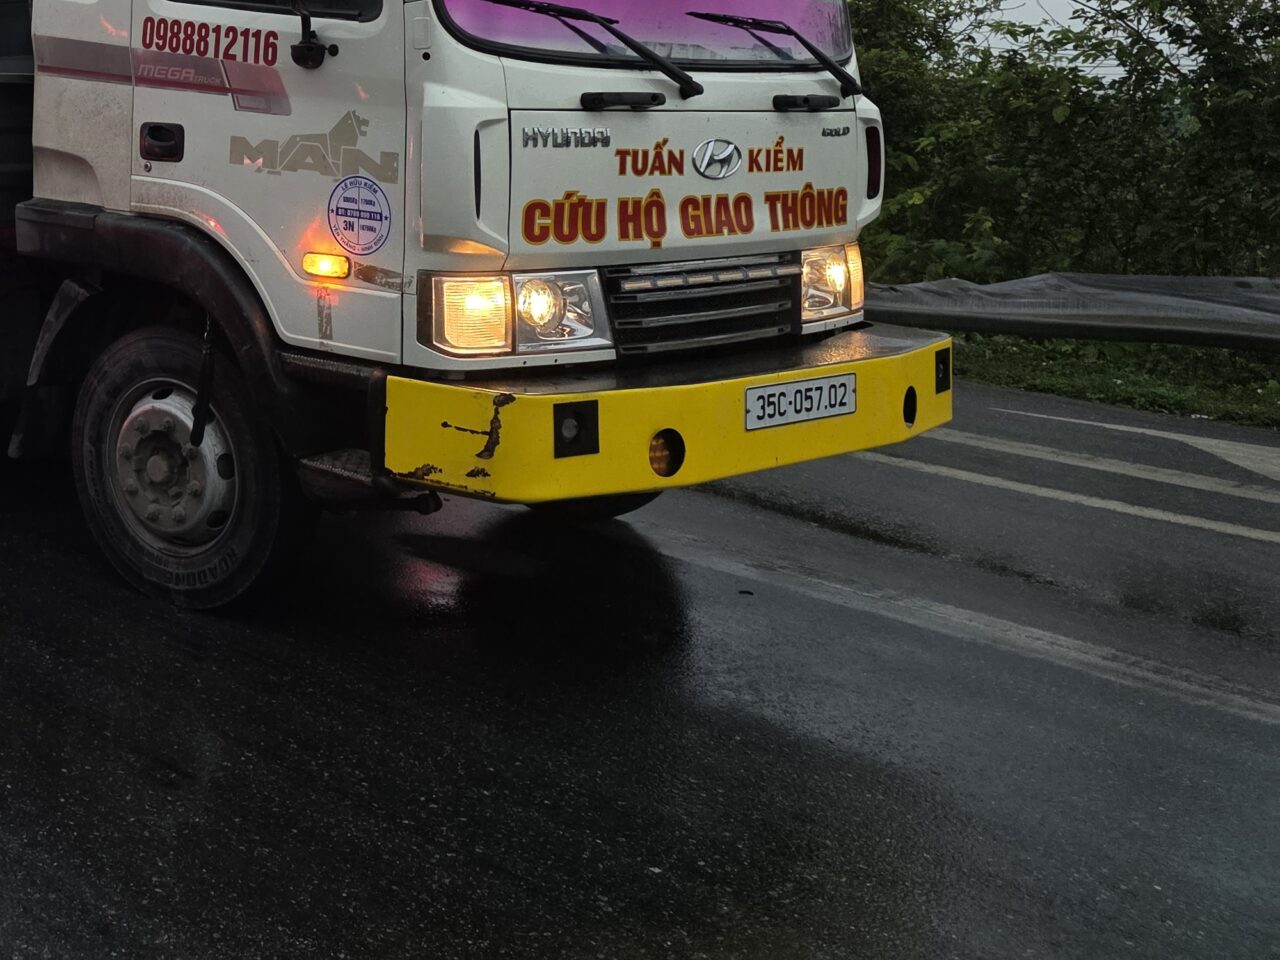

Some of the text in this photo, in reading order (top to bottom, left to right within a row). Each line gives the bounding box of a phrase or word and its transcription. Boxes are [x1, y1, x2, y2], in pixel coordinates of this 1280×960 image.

[142, 16, 279, 66] 0988812116
[138, 64, 195, 80] MEGA
[522, 127, 611, 148] HYUNDAI
[614, 134, 805, 177] TUẤN KIỂM
[229, 134, 400, 185] MAN
[343, 220, 355, 233] 3N
[521, 181, 848, 250] CỨU HỘ GIAO THÔNG
[756, 382, 848, 421] 35C-057.02
